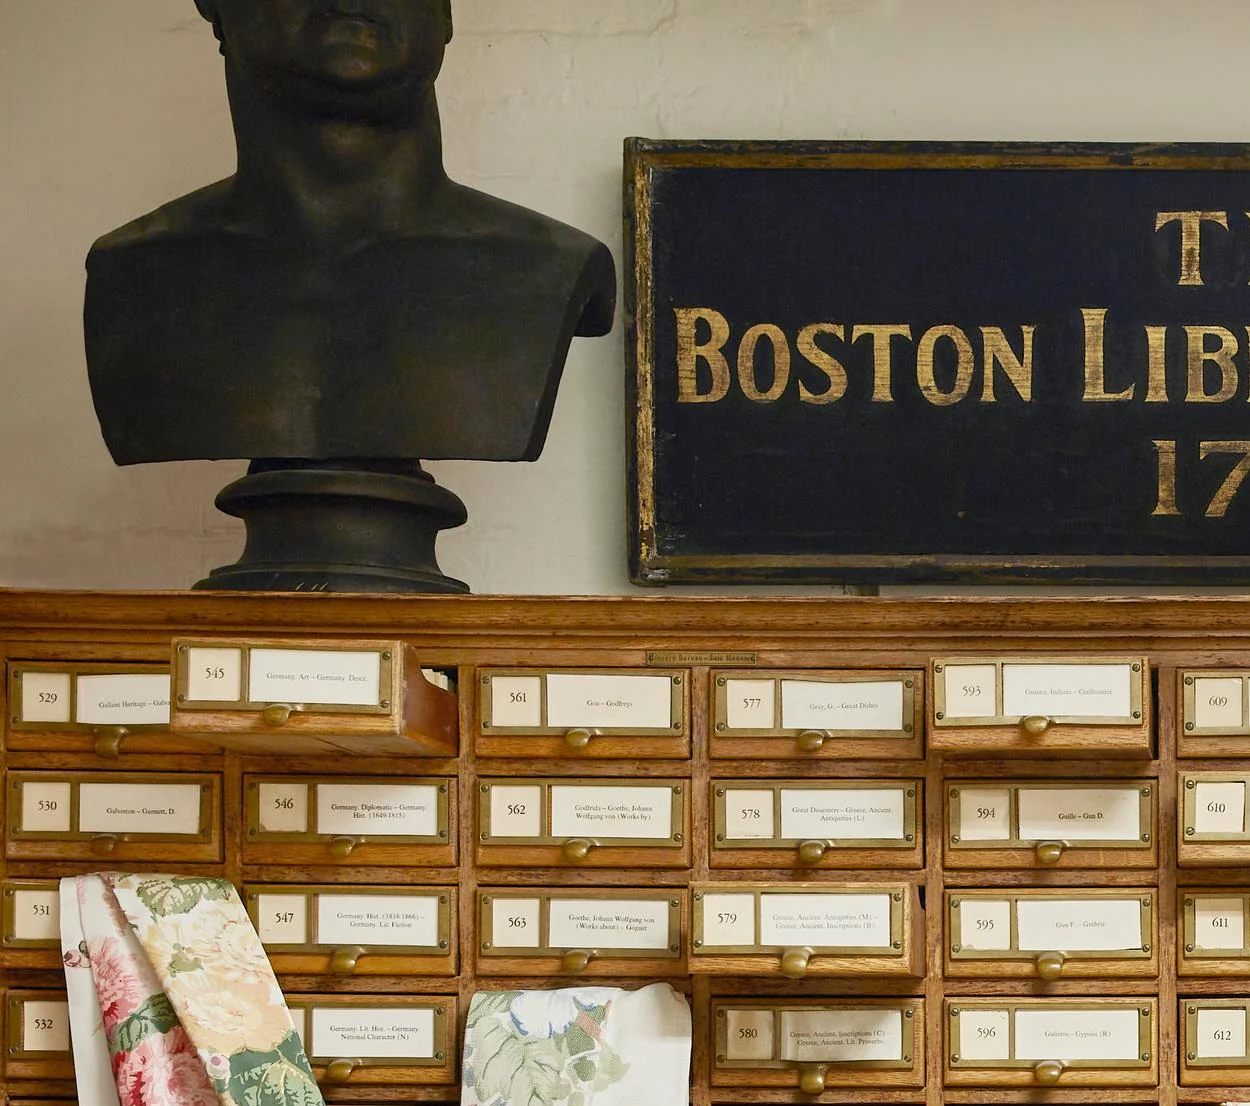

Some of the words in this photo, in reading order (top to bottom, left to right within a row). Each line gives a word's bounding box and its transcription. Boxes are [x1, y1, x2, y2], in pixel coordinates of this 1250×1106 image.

[675, 308, 1033, 404] BOSTON
[205, 667, 225, 680] 545
[509, 691, 527, 703] 561
[962, 685, 982, 697] 593
[38, 692, 58, 704] 529
[743, 698, 762, 709] 577
[1208, 695, 1228, 707] 609
[38, 800, 58, 812] 530
[274, 797, 294, 810] 546
[507, 803, 526, 815] 562
[1207, 801, 1226, 813] 610
[105, 807, 136, 815] Galveston
[575, 812, 604, 821] Wolfgang
[617, 812, 640, 820] (Works
[640, 813, 651, 822] by)
[741, 808, 761, 820] 578
[976, 807, 996, 819] 594
[1058, 812, 1077, 820] Guille
[32, 904, 50, 916] 531
[275, 911, 294, 924] 547
[508, 916, 527, 929] 563
[717, 912, 737, 924] 579
[1211, 916, 1228, 928] 611
[976, 919, 995, 931] 595
[34, 1018, 53, 1030] 532
[340, 1033, 367, 1041] National
[366, 1033, 396, 1041] Character
[397, 1033, 410, 1041] (N)
[738, 1028, 758, 1039] 580
[977, 1026, 997, 1039] 596
[1213, 1029, 1232, 1041] 612
